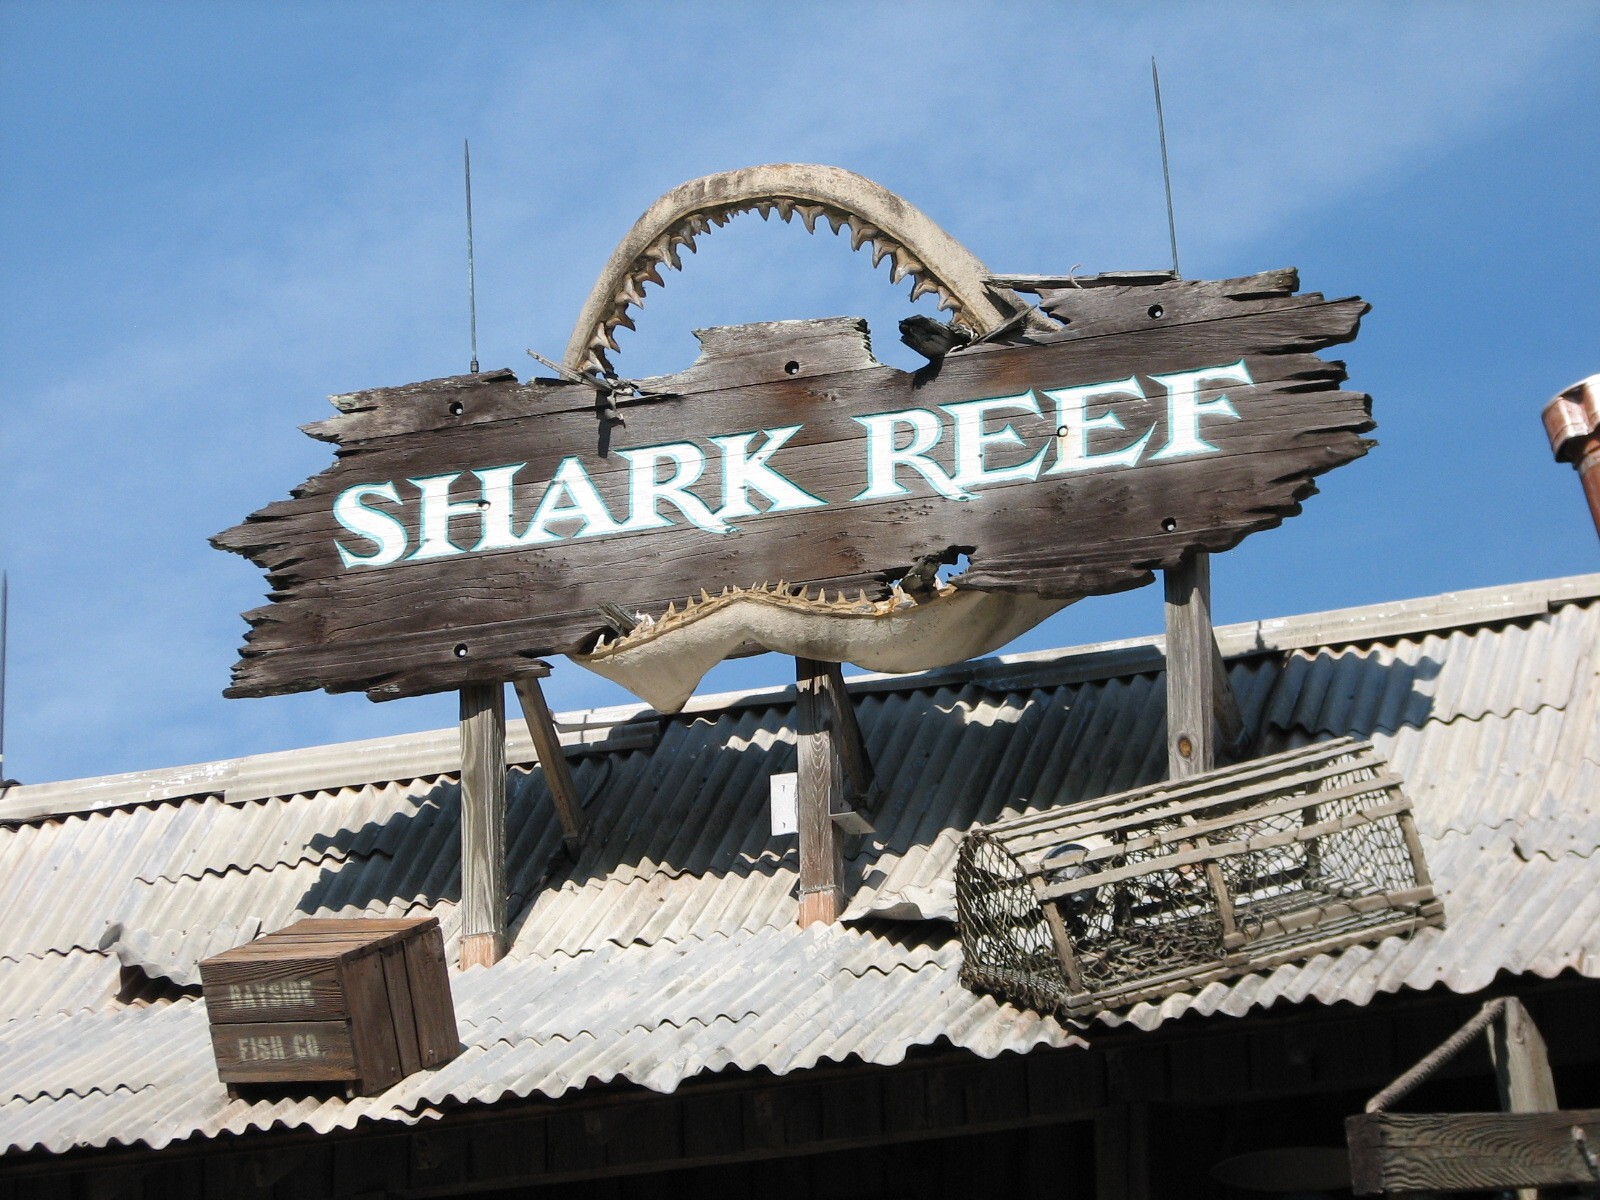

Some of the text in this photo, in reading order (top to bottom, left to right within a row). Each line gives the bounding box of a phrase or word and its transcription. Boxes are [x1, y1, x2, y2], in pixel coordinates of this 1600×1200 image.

[333, 359, 1255, 569] SHARK REEF
[238, 1035, 285, 1062] FISH
